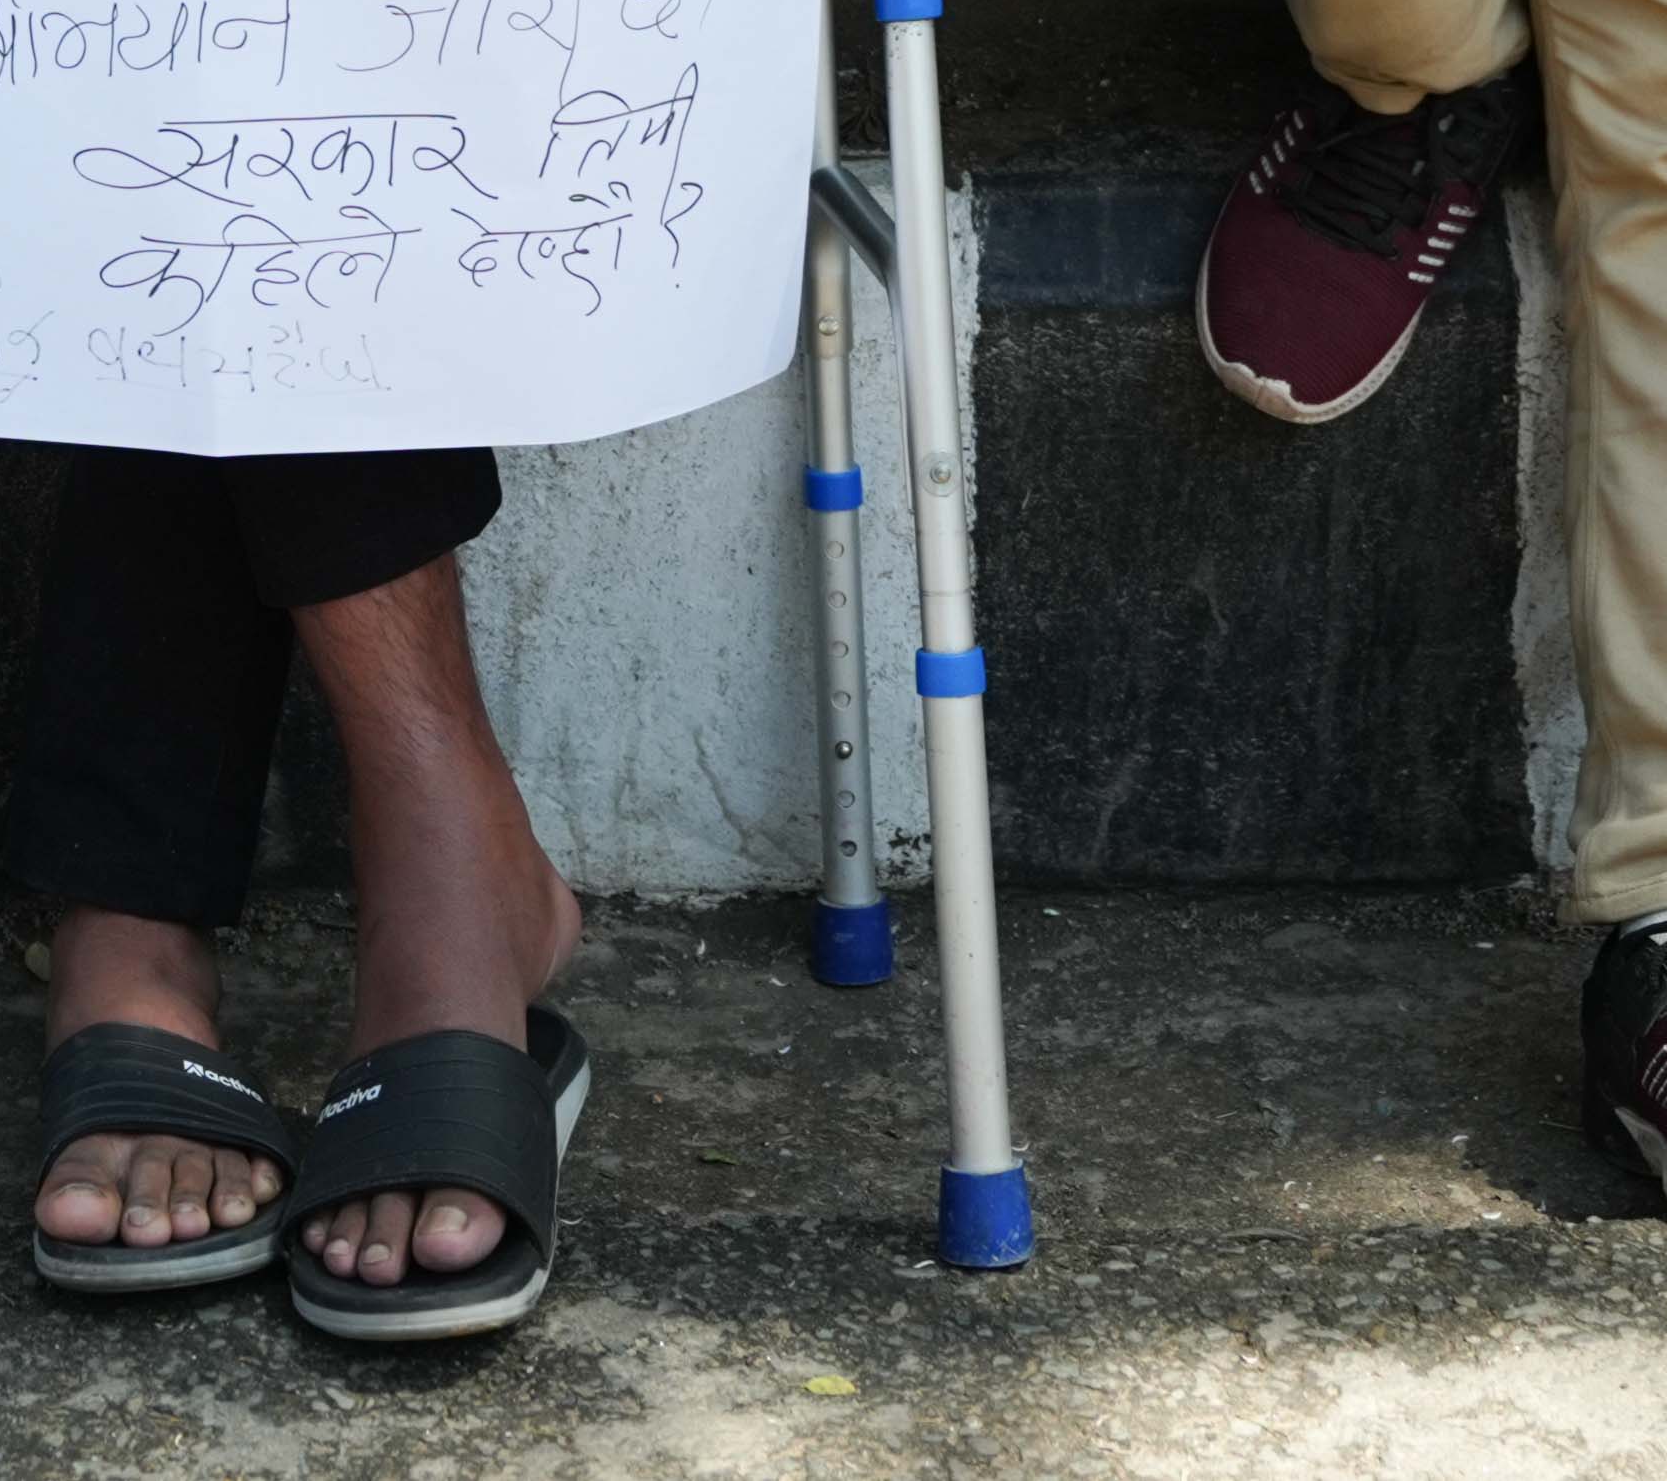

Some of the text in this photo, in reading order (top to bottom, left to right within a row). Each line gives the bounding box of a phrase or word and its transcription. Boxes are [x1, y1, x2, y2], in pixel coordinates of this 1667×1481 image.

[73, 113, 500, 207] सरकार
[99, 206, 422, 337] कहिले
[203, 1070, 265, 1104] activa
